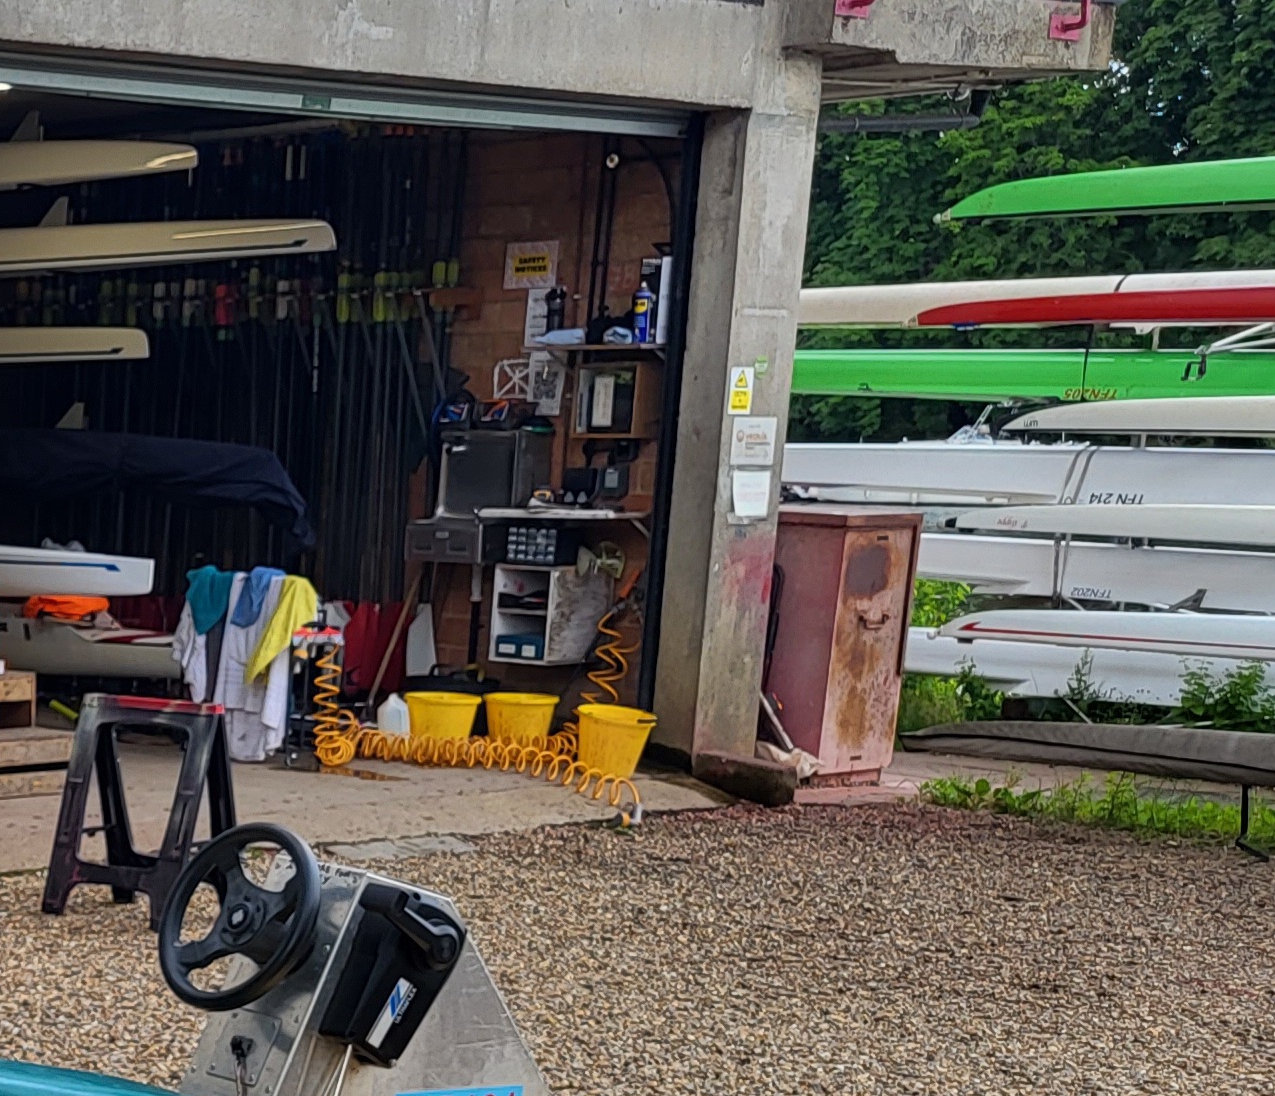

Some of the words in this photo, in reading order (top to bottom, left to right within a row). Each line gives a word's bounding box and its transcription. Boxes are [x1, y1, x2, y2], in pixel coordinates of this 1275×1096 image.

[1089, 492, 1113, 505] 214
[1116, 493, 1144, 505] TFN
[1071, 586, 1112, 599] TFN202
